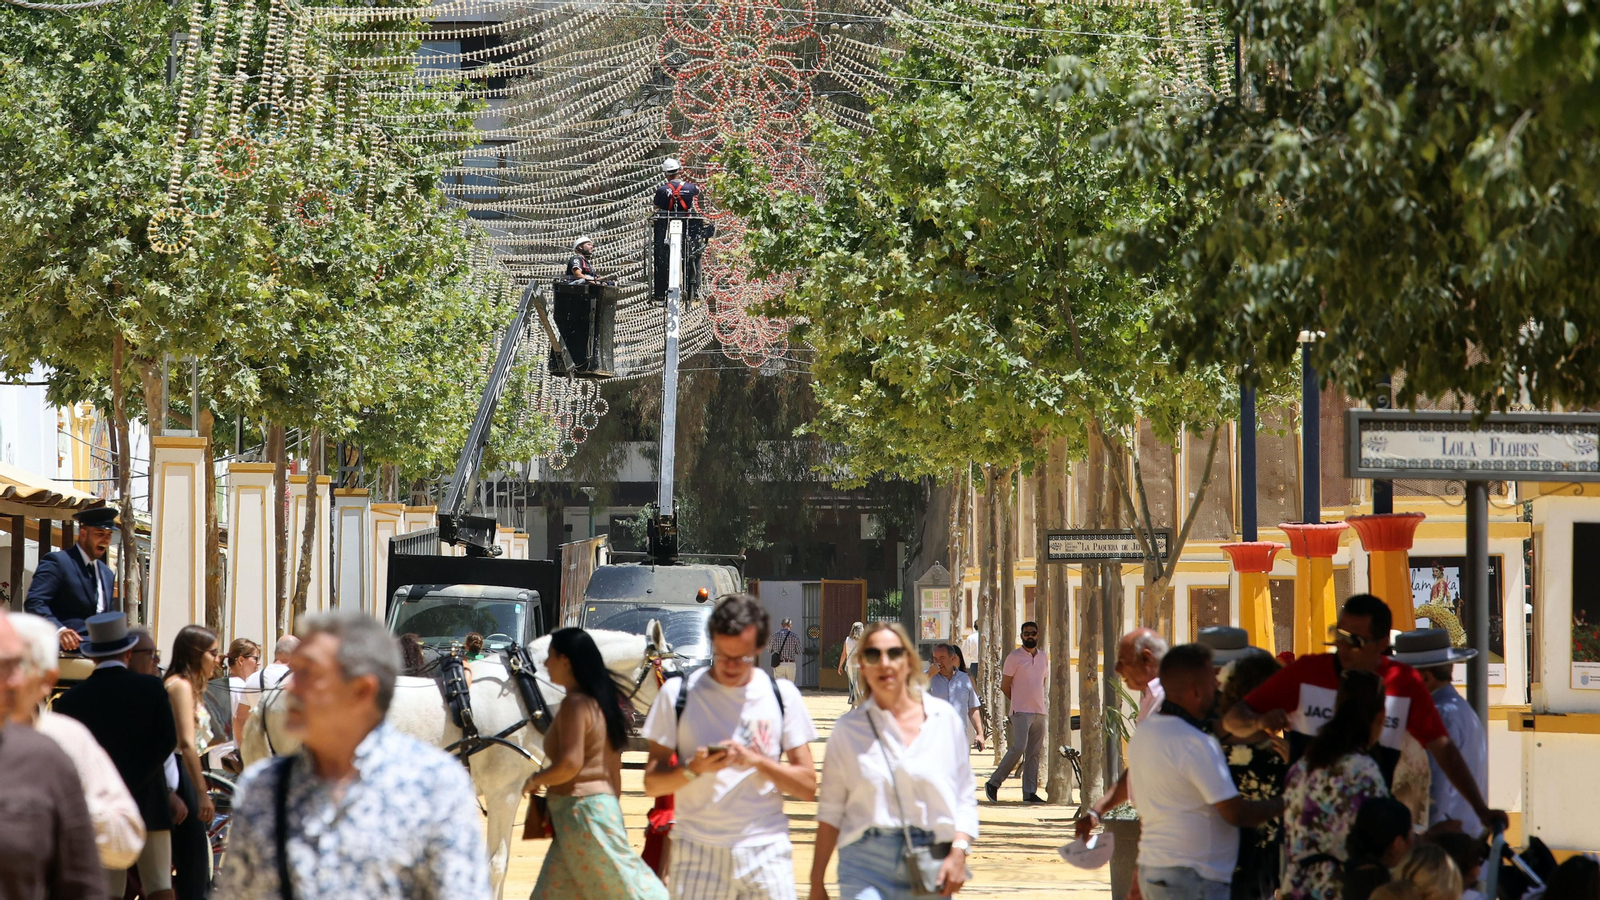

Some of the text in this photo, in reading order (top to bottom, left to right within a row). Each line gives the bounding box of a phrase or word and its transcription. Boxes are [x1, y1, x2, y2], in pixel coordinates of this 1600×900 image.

[1441, 436, 1539, 458] LOLA FLORES
[1304, 705, 1334, 719] JAC
